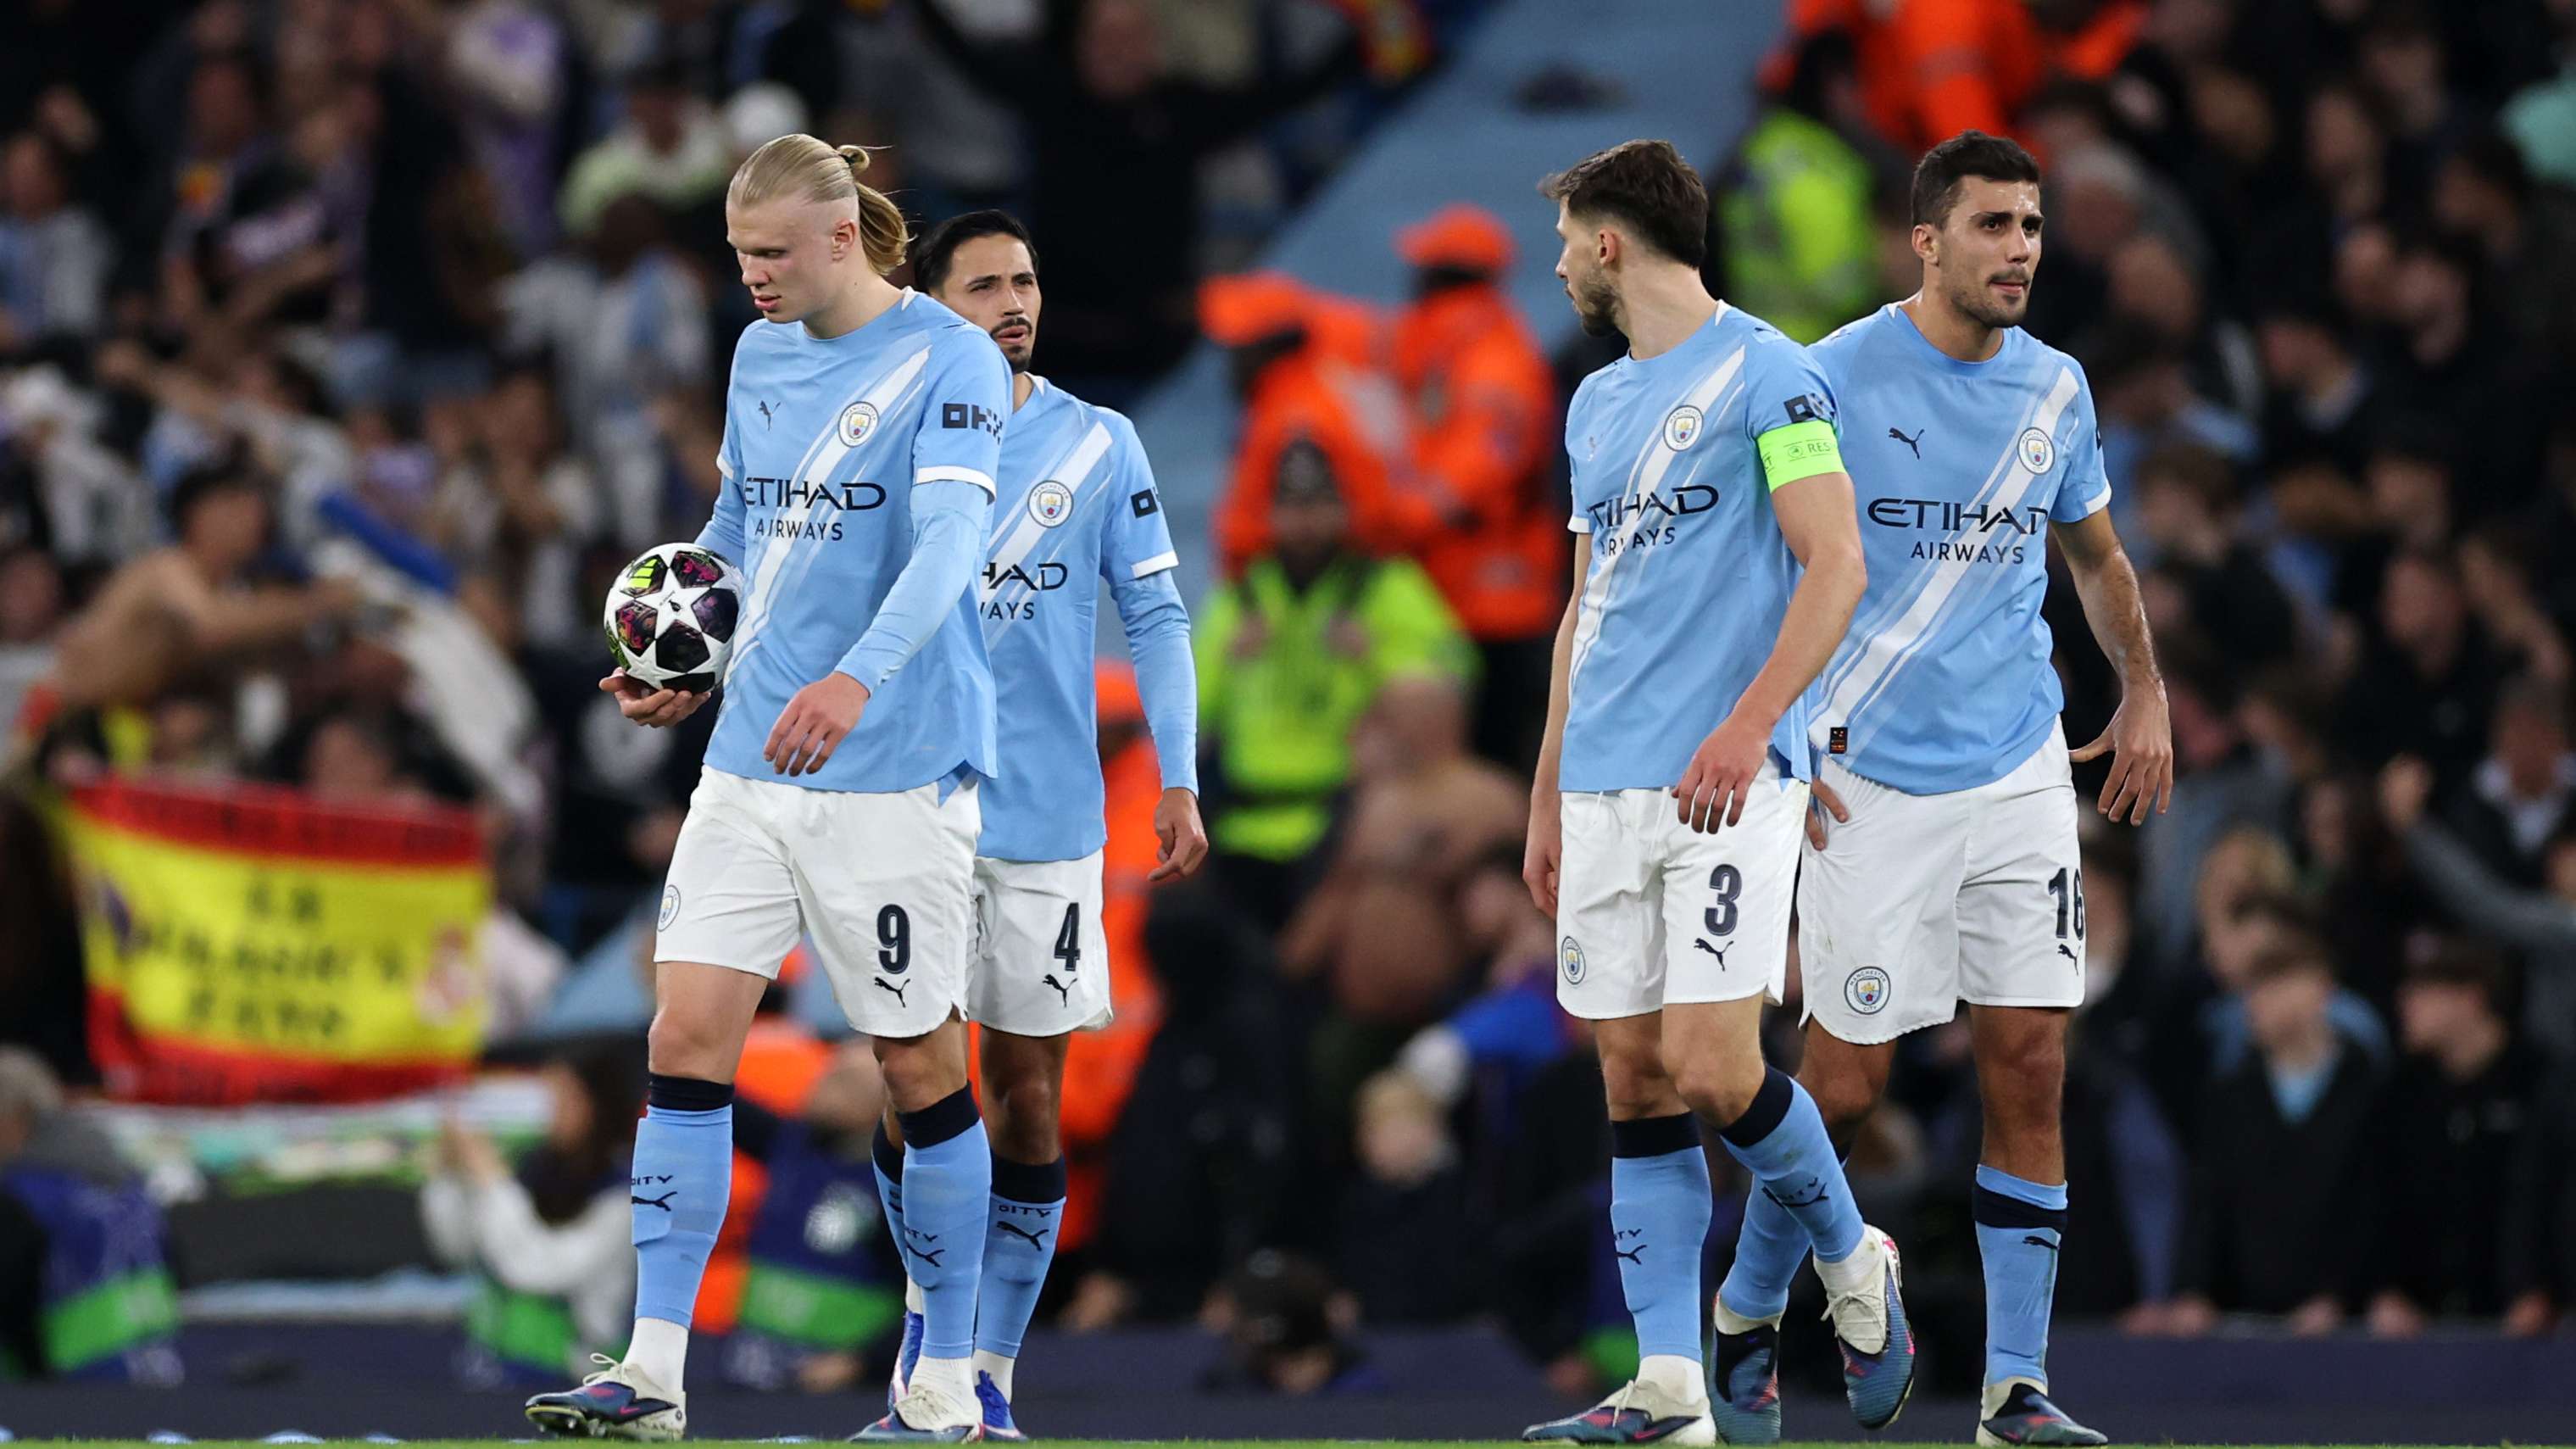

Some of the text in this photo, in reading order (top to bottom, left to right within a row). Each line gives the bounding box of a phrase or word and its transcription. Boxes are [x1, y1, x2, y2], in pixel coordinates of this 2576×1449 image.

[754, 518, 843, 541] AIRWAYS
[1587, 484, 1719, 529] TIHAD
[1910, 541, 2024, 565] AIRWAYS
[1704, 863, 1743, 937] 3
[876, 904, 910, 974] 9
[1054, 902, 1081, 972] 4
